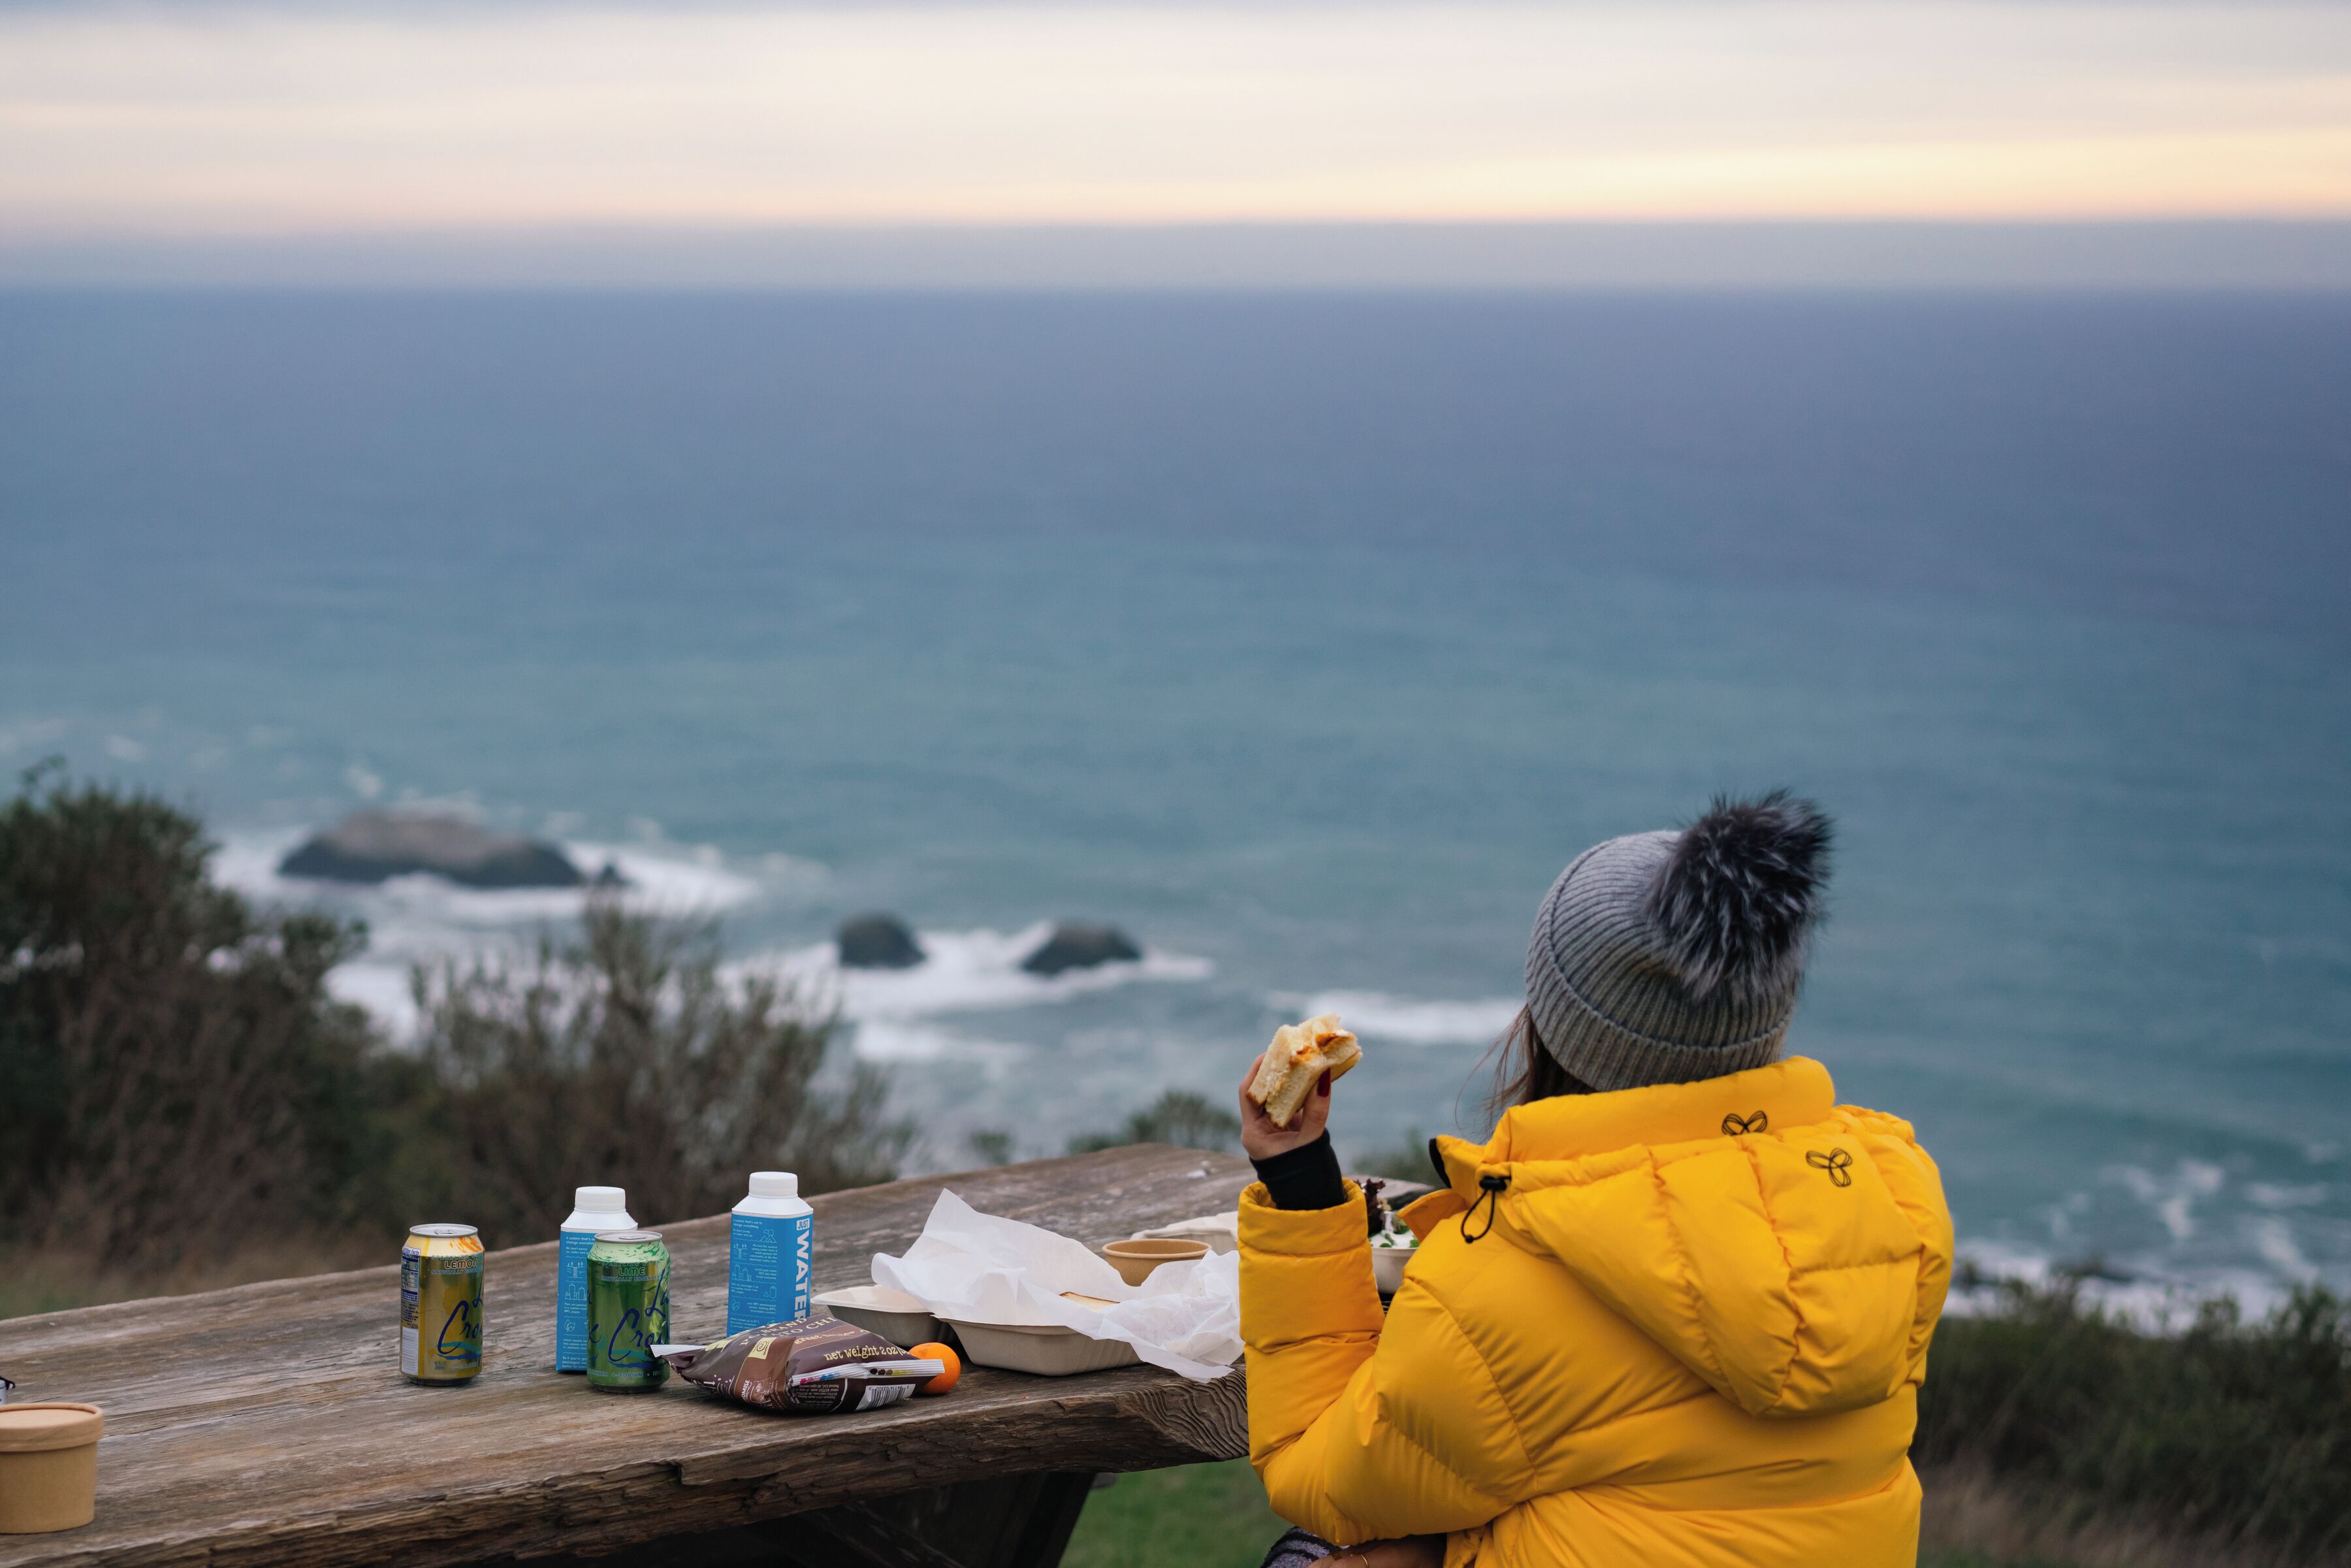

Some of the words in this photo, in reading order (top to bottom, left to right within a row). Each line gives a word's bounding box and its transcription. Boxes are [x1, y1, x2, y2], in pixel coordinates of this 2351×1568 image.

[445, 1258, 479, 1270] LEMON
[618, 1267, 646, 1277] LIME
[438, 1300, 482, 1354] Cro
[760, 1318, 807, 1334] BRAND
[806, 1317, 839, 1330] CHI
[824, 1351, 844, 1361] net
[844, 1345, 880, 1358] weight
[881, 1347, 887, 1355] 2
